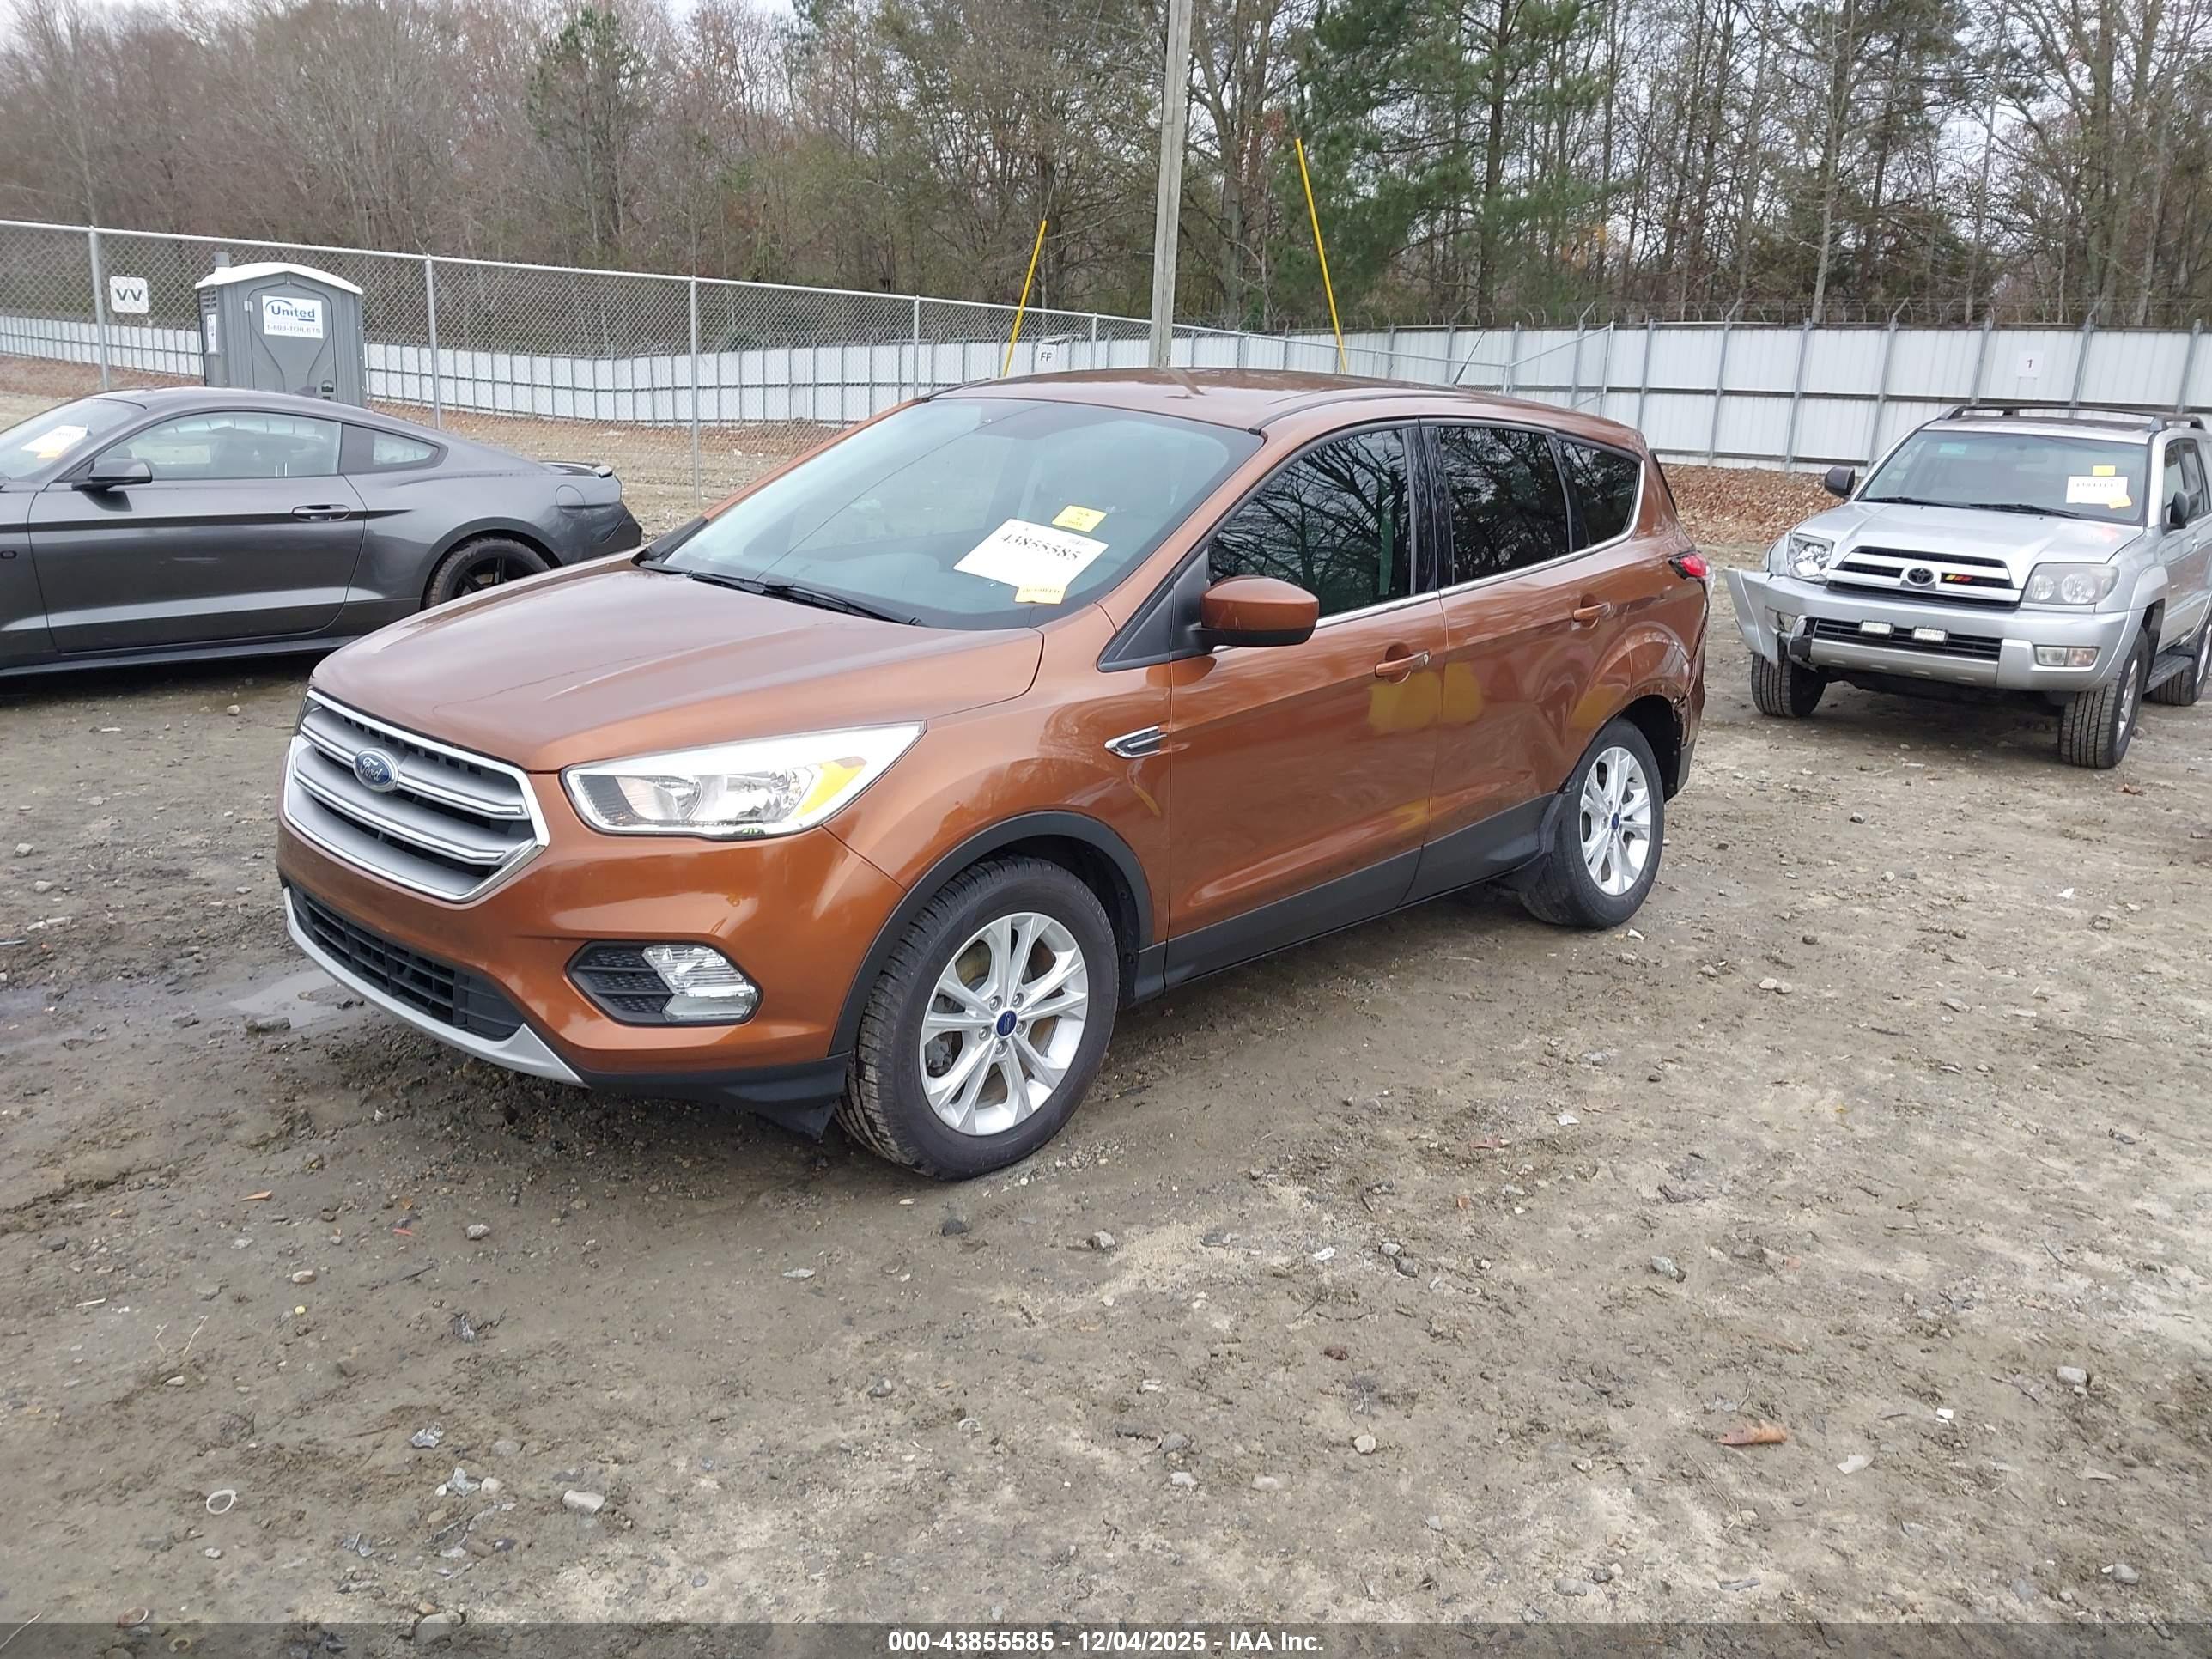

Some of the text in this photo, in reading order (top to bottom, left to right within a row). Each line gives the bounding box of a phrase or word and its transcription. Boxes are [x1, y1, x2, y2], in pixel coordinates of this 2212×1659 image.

[271, 305, 315, 319] United
[1040, 351, 1052, 362] FF
[2027, 358, 2033, 369] 1
[1001, 533, 1082, 561] 43855585
[360, 757, 384, 781] Ford
